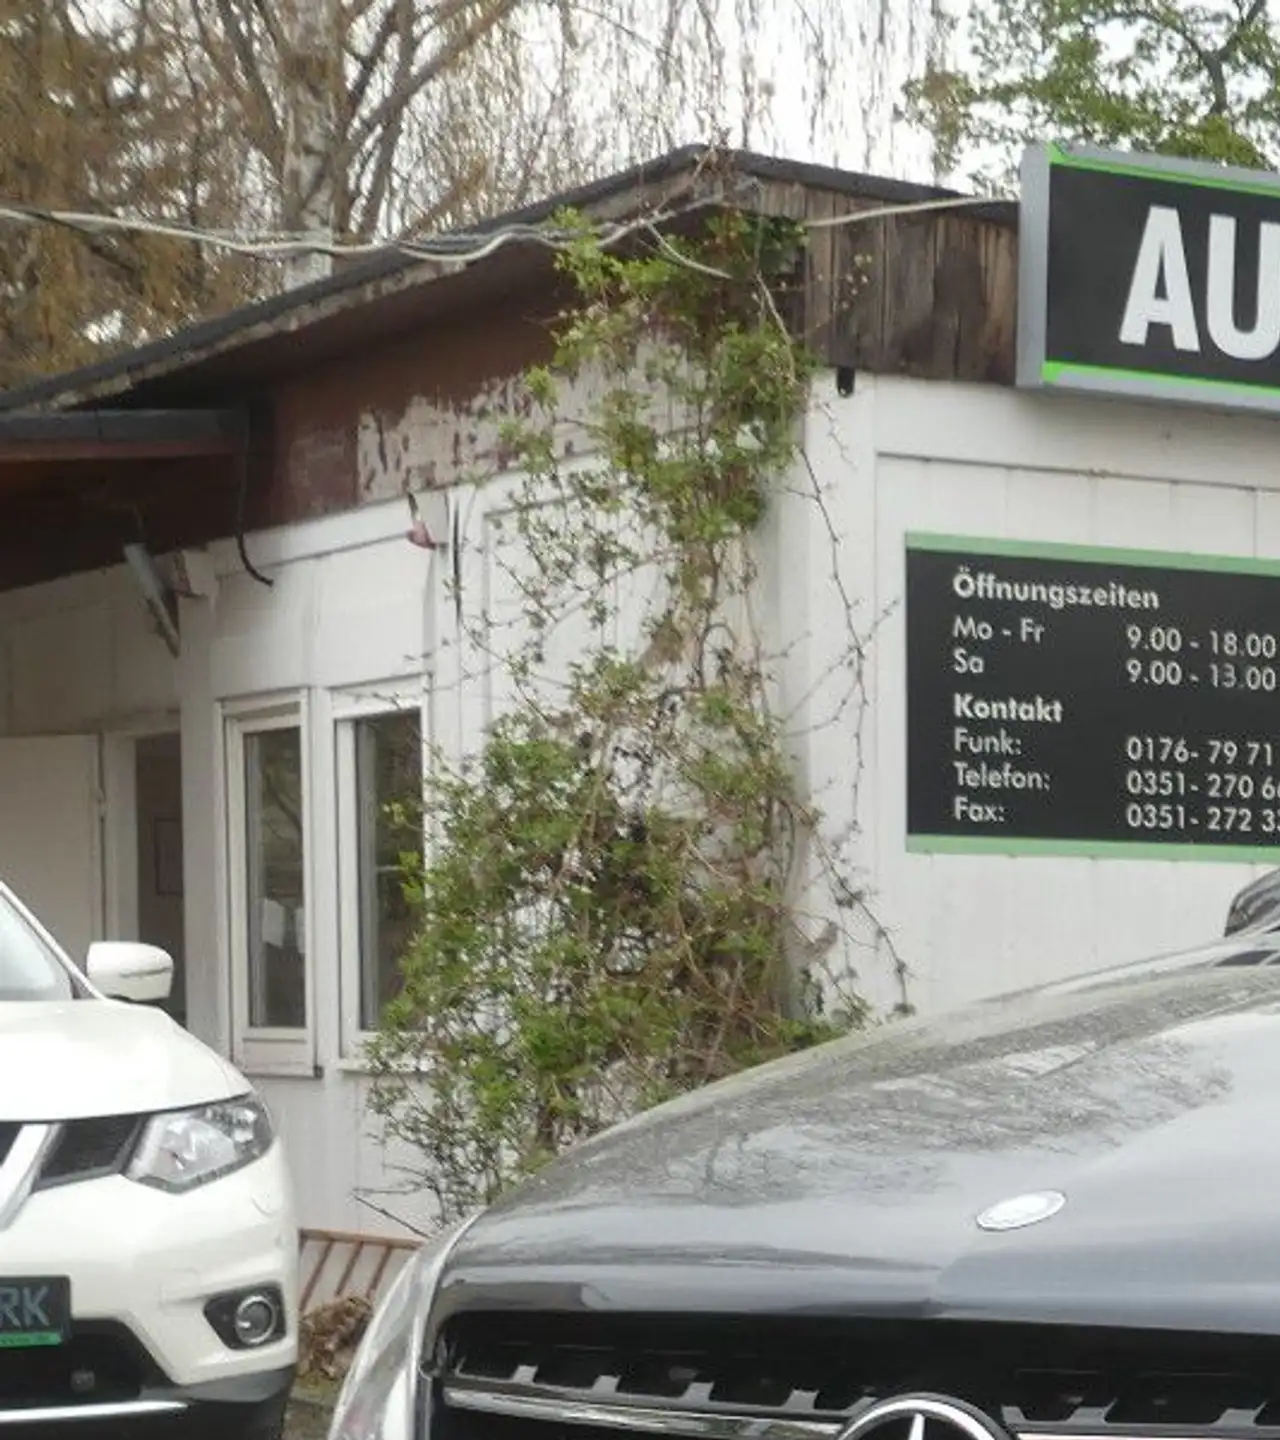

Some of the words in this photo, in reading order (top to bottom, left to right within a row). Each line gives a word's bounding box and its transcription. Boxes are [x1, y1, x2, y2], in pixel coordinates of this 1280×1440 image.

[953, 566, 1160, 609] Öffnungszeiten
[952, 615, 993, 640] Mo
[1020, 617, 1044, 643] Fr
[1126, 624, 1182, 652] 9.00
[1209, 629, 1277, 659] 18.00
[953, 647, 985, 674] Sa
[1126, 658, 1182, 685] 9.00
[1209, 663, 1277, 691] 13.00
[953, 692, 1064, 723] Kontakt
[954, 726, 1022, 755] Funk:
[1207, 740, 1238, 764] 79
[1247, 742, 1273, 767] 71
[953, 761, 1051, 791] Telefon:
[1207, 773, 1254, 799] 270
[954, 795, 1005, 822] Fax:
[1207, 806, 1252, 832] 272
